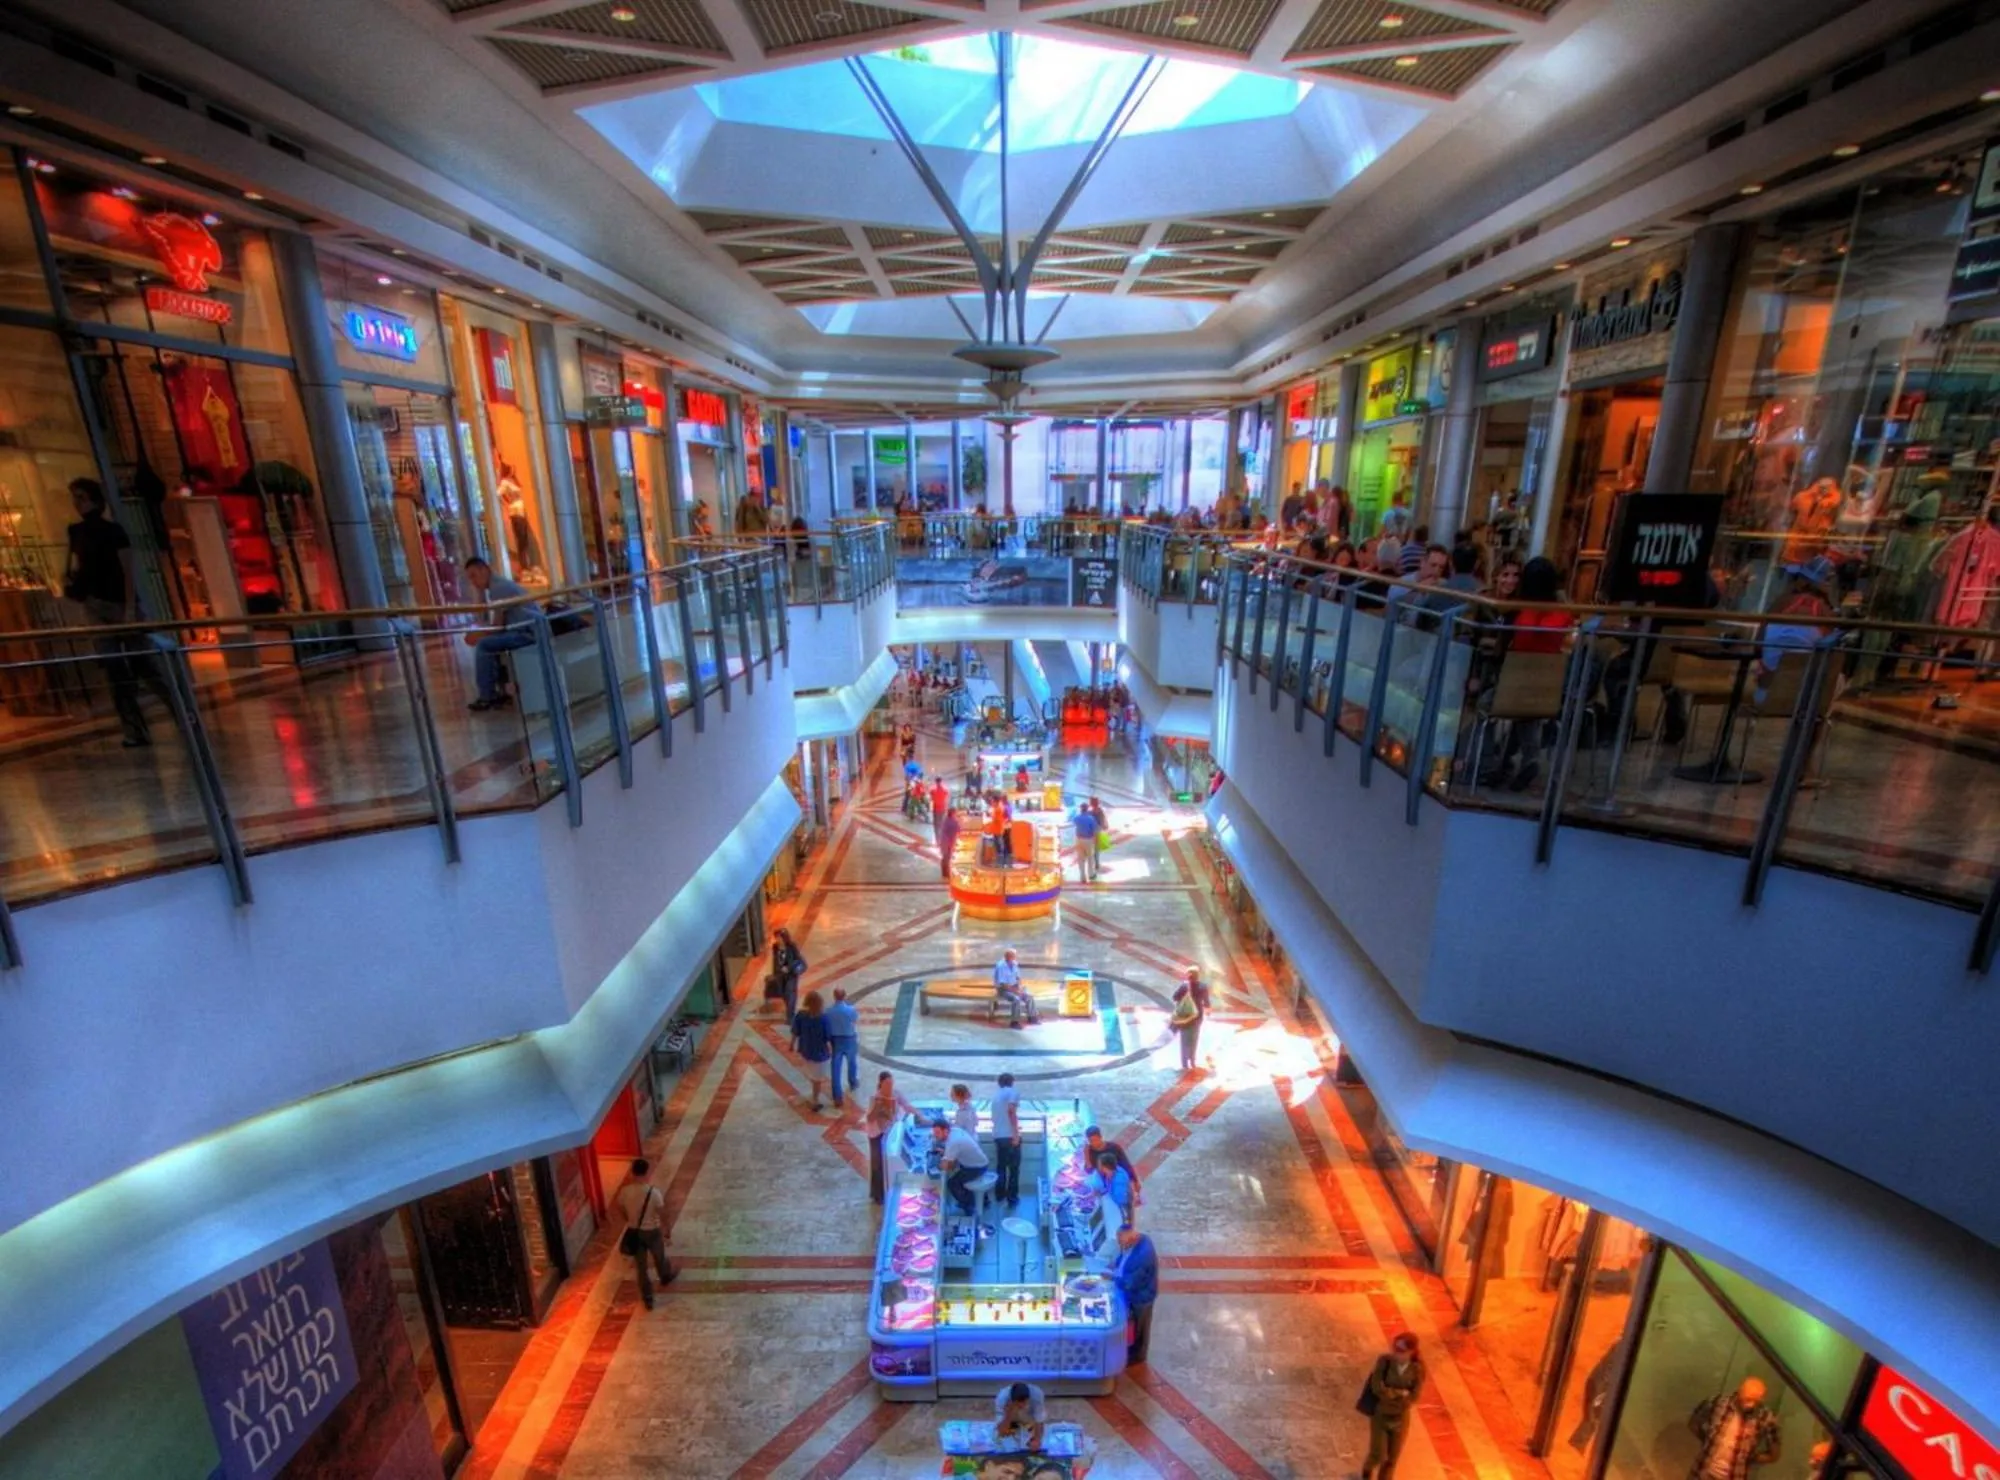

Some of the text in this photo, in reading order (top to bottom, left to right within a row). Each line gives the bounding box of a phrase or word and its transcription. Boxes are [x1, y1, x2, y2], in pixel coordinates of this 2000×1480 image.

[1632, 523, 1703, 565] ארומה
[223, 1307, 336, 1441] כמו שלא
[232, 1284, 311, 1366] רנואר
[243, 1353, 341, 1473] הכרתם
